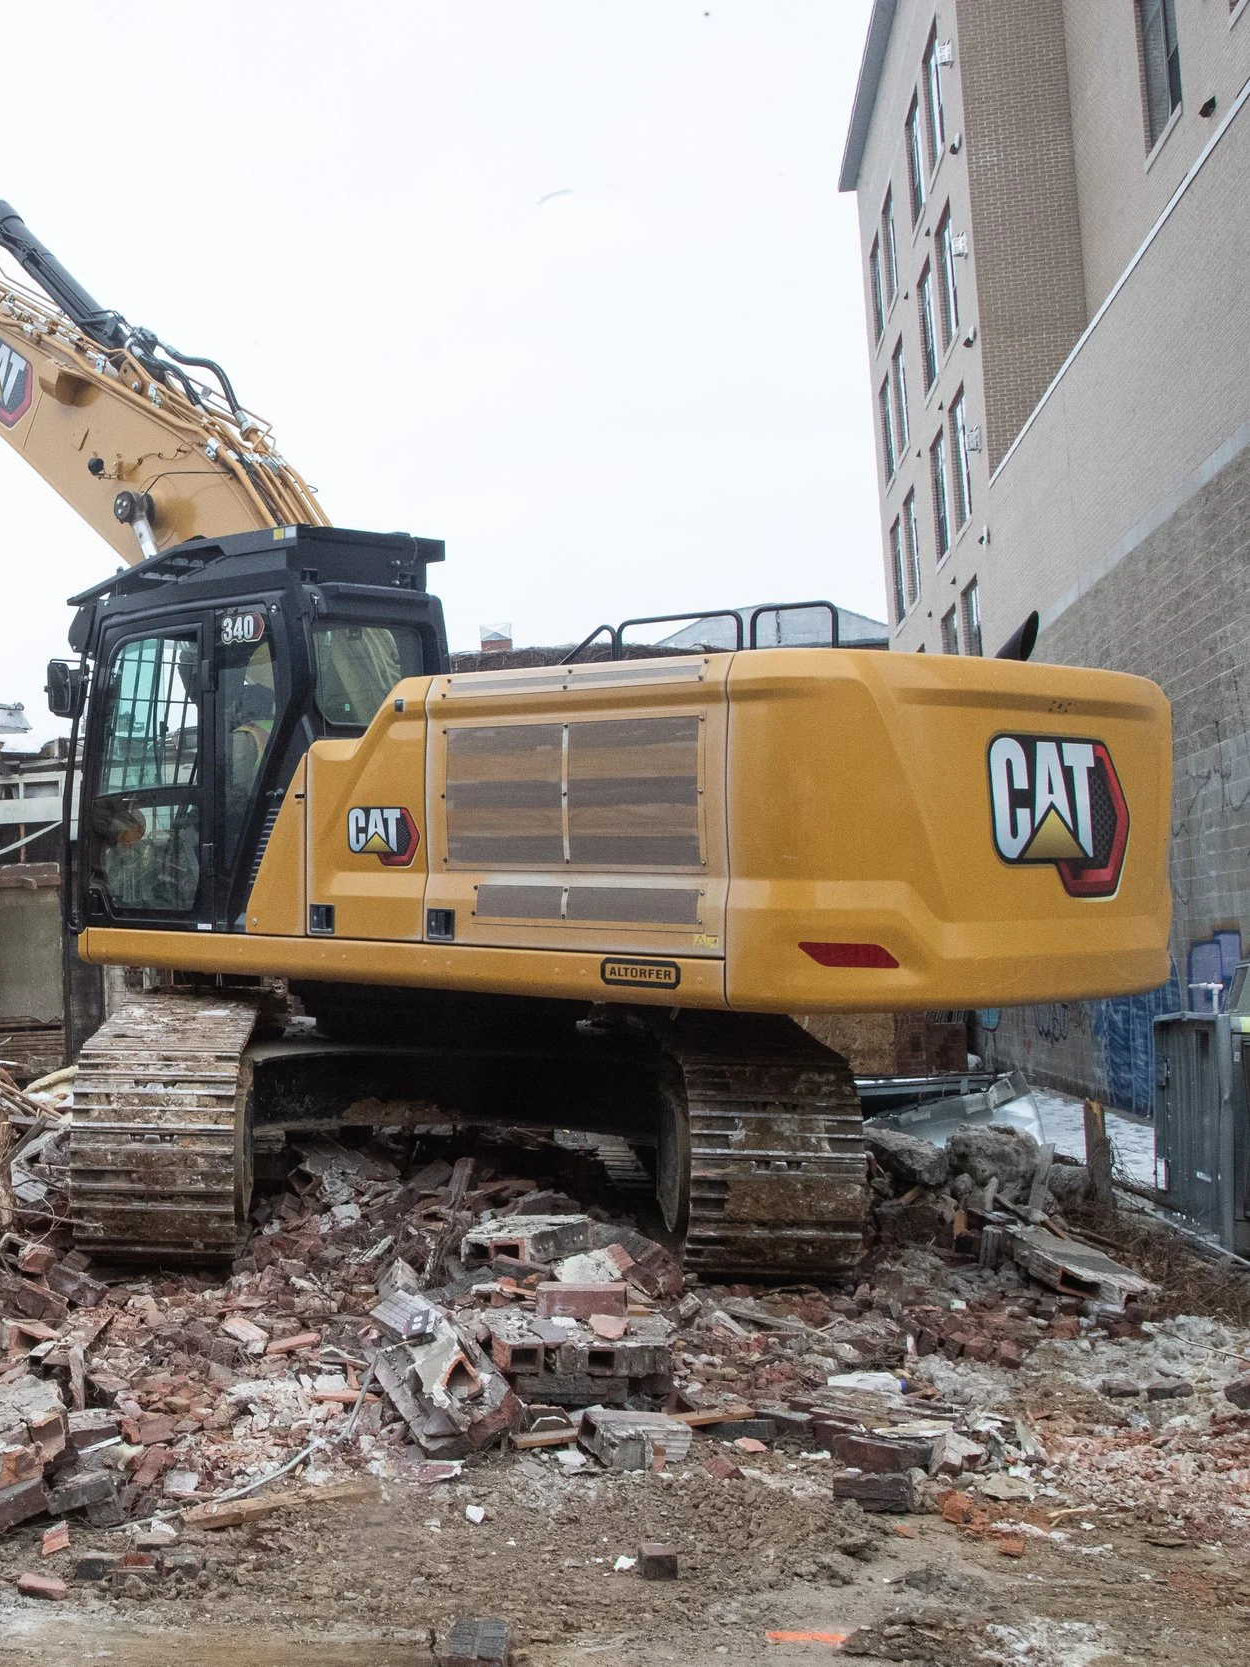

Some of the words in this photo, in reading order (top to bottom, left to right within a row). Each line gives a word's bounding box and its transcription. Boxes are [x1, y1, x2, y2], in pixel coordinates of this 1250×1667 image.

[223, 615, 254, 642] 340
[990, 735, 1095, 860] CAT
[349, 807, 401, 853] CAT
[609, 966, 672, 980] ALTORFER
